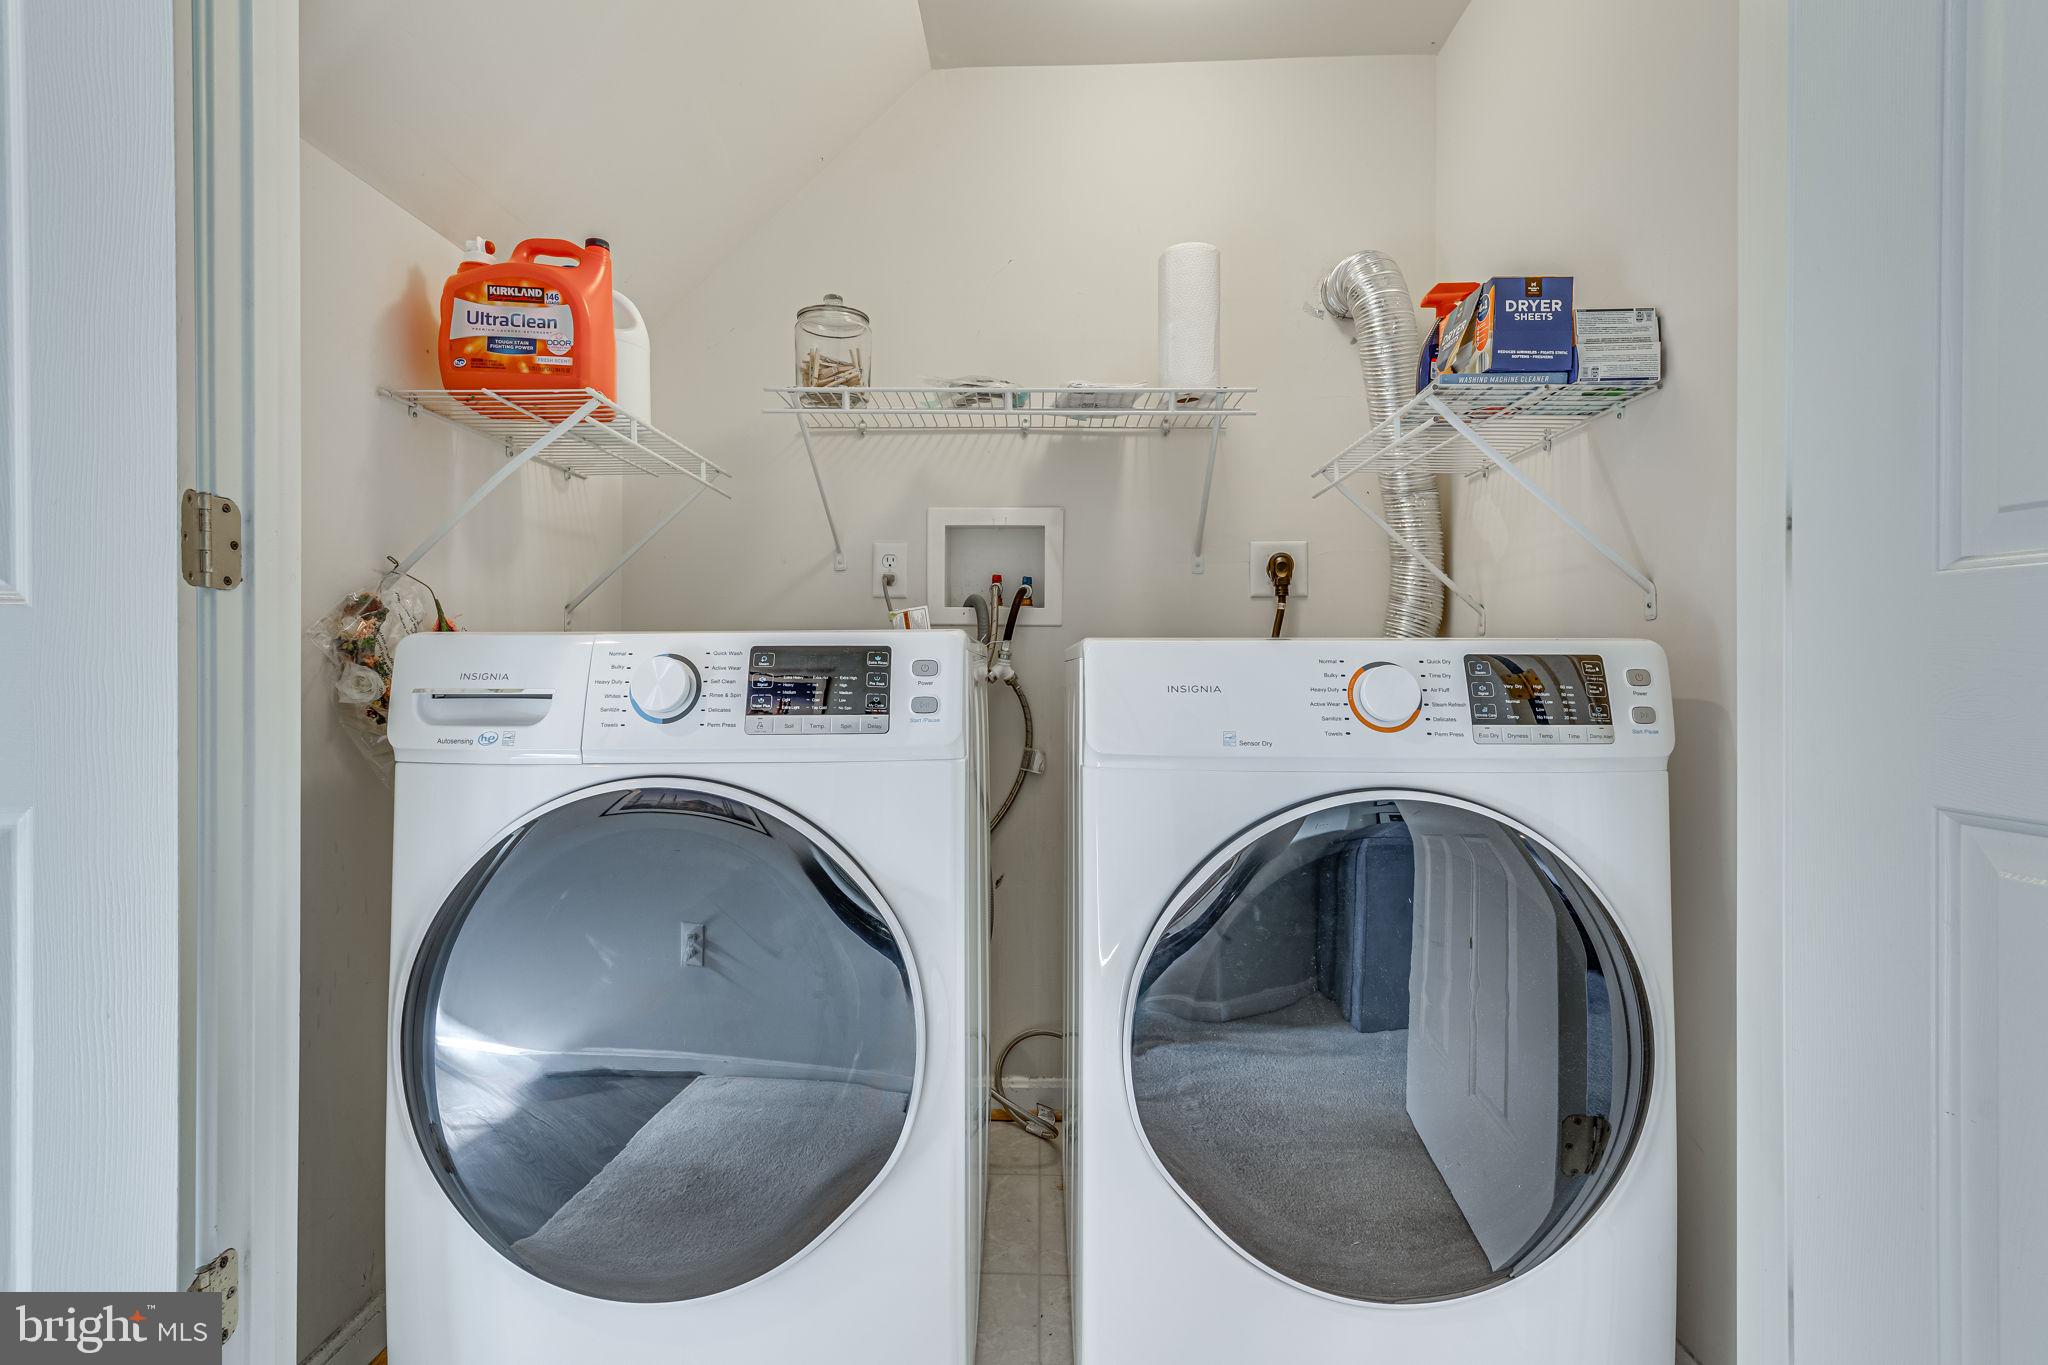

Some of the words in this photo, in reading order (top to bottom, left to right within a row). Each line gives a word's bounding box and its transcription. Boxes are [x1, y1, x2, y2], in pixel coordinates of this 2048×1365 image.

[489, 286, 543, 297] KIRKLAND
[1505, 300, 1562, 312] DRYER
[466, 310, 558, 329] UltraClean
[1514, 312, 1553, 320] SHEETS
[481, 734, 495, 742] he
